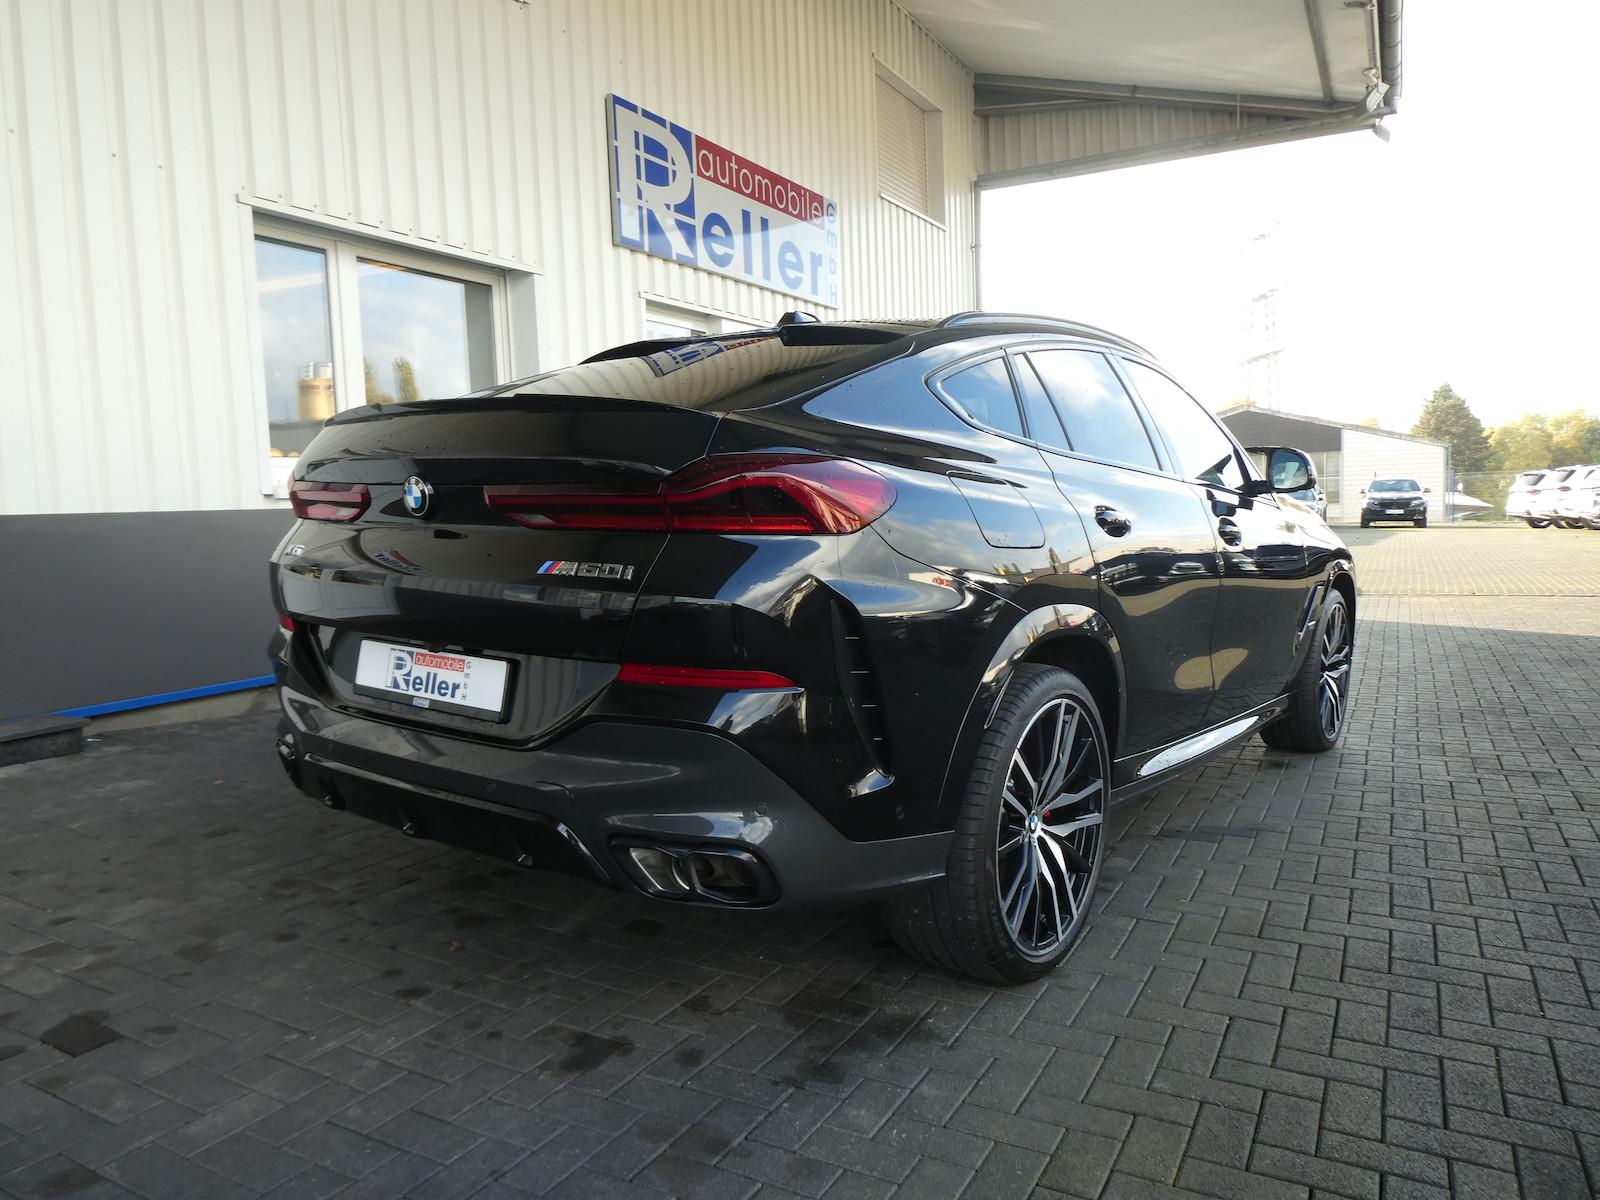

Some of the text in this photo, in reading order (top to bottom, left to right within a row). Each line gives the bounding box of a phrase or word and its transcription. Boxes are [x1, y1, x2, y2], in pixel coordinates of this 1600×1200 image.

[614, 103, 823, 297] Reller
[698, 148, 823, 225] automobile
[385, 648, 461, 699] Reller
[415, 653, 465, 672] automobile
[461, 661, 471, 700] GmbH
